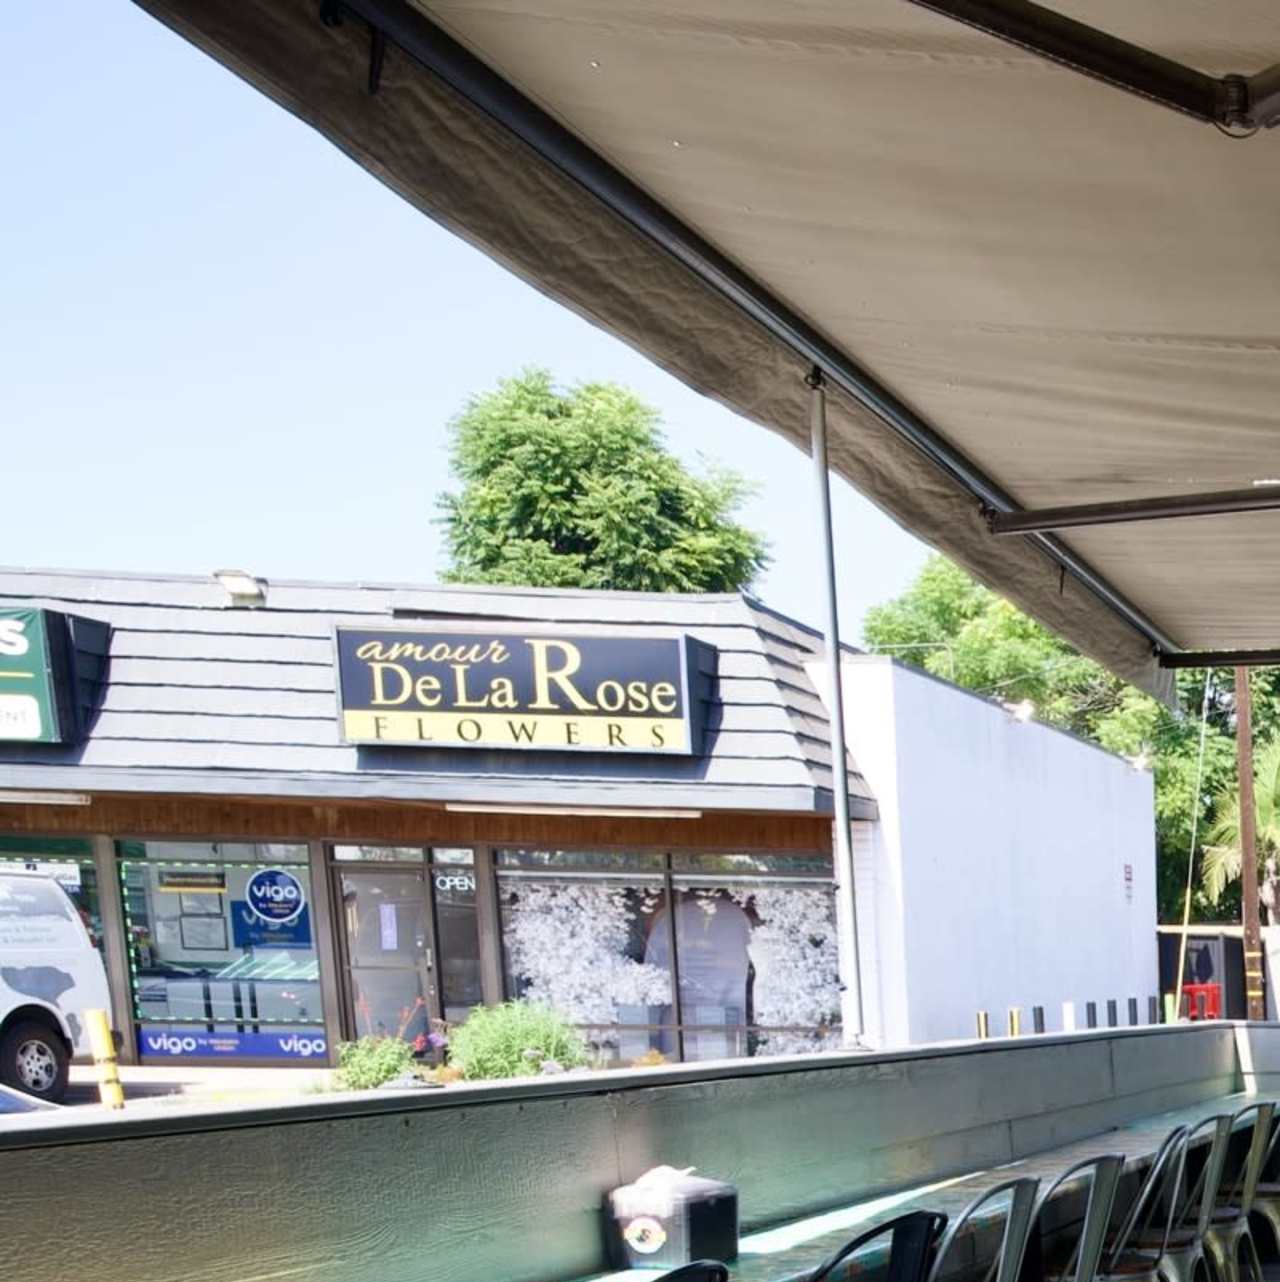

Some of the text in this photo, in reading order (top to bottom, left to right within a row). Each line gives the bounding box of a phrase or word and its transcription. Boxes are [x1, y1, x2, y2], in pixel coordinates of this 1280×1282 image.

[356, 639, 510, 664] amour
[524, 638, 678, 713] Rose
[373, 716, 666, 748] FLOWERS
[251, 880, 298, 902] vigo
[435, 874, 476, 891] OPEN
[148, 1032, 198, 1055] vigo
[279, 1036, 326, 1057] vigo
